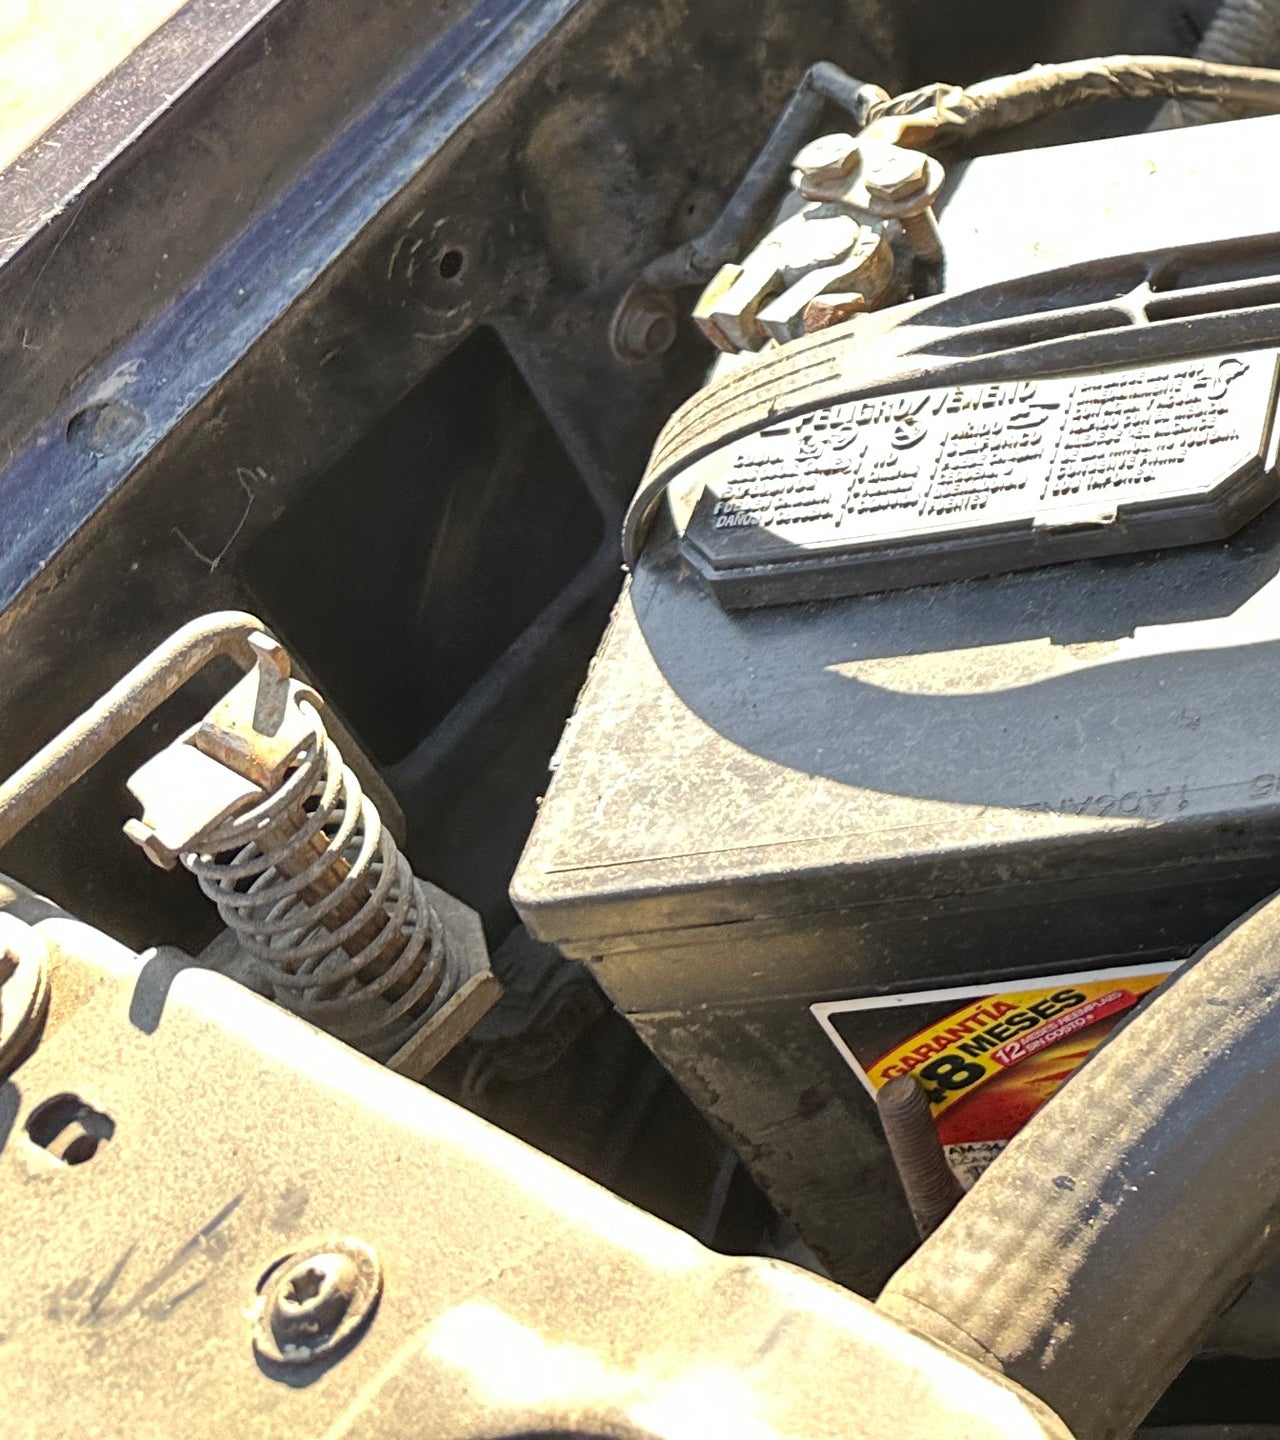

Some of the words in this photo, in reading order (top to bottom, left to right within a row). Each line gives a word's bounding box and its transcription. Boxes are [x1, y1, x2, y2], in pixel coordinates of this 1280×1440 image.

[881, 998, 1020, 1080] GARANTÍA
[959, 987, 1088, 1059] MESES
[994, 1042, 1027, 1065] 12
